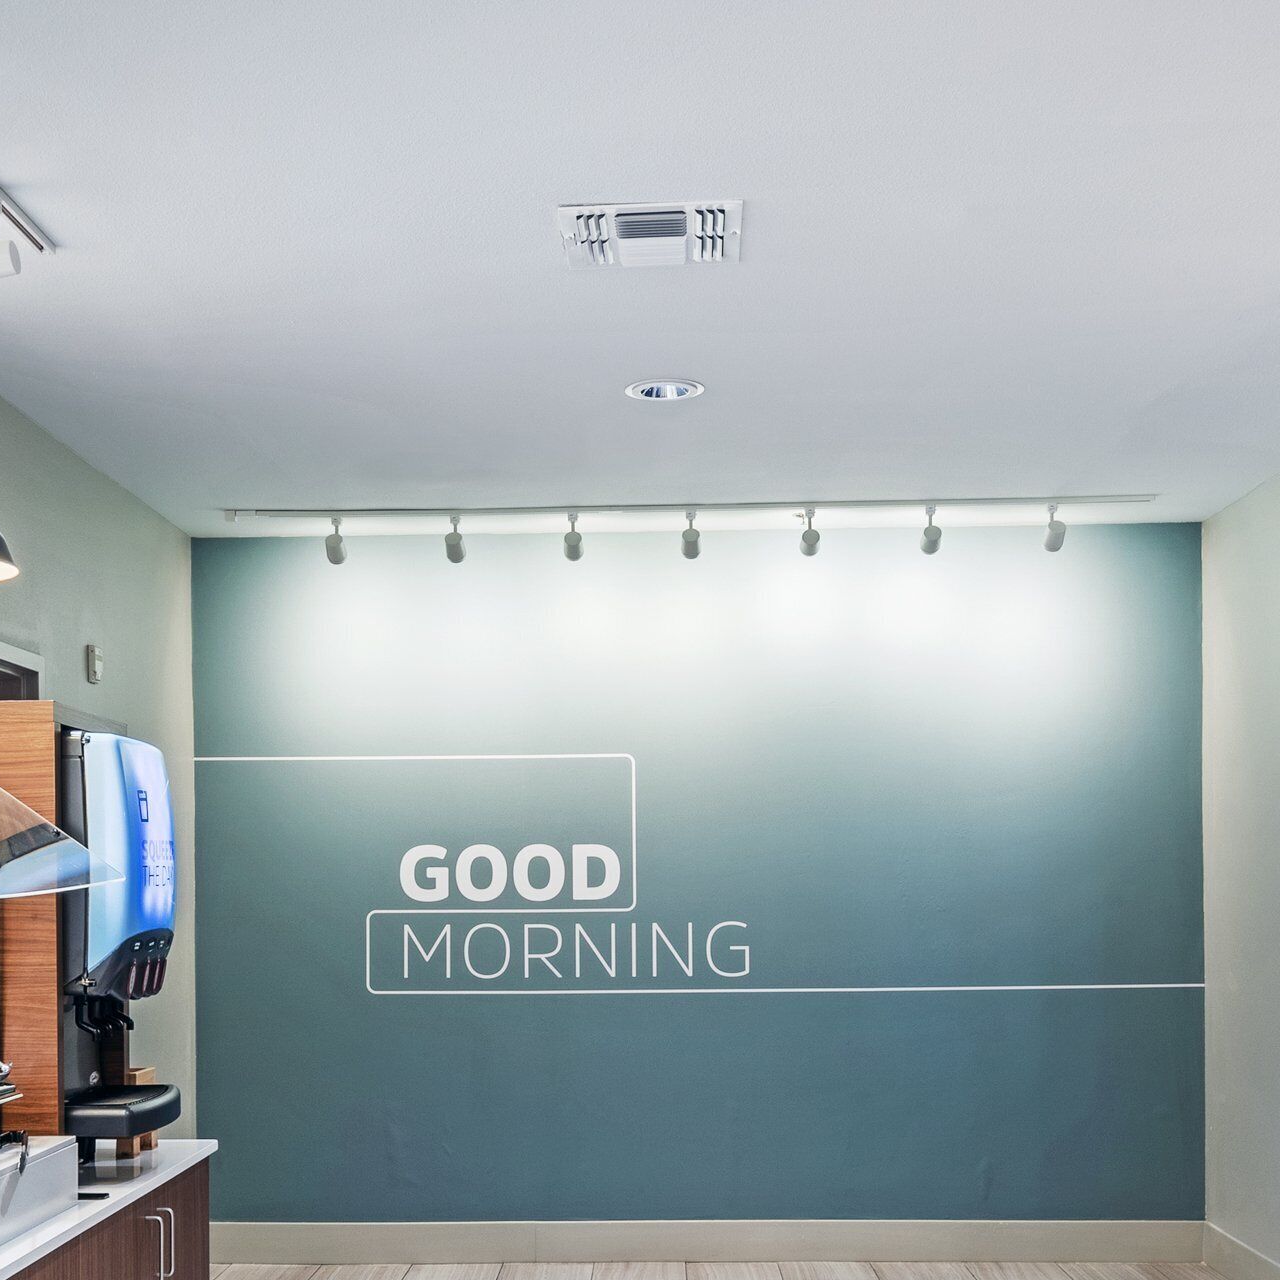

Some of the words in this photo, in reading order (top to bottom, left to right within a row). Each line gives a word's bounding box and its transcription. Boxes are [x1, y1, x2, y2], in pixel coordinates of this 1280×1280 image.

[142, 865, 161, 887] THE
[399, 843, 621, 903] GOOD
[402, 920, 751, 980] MORNING
